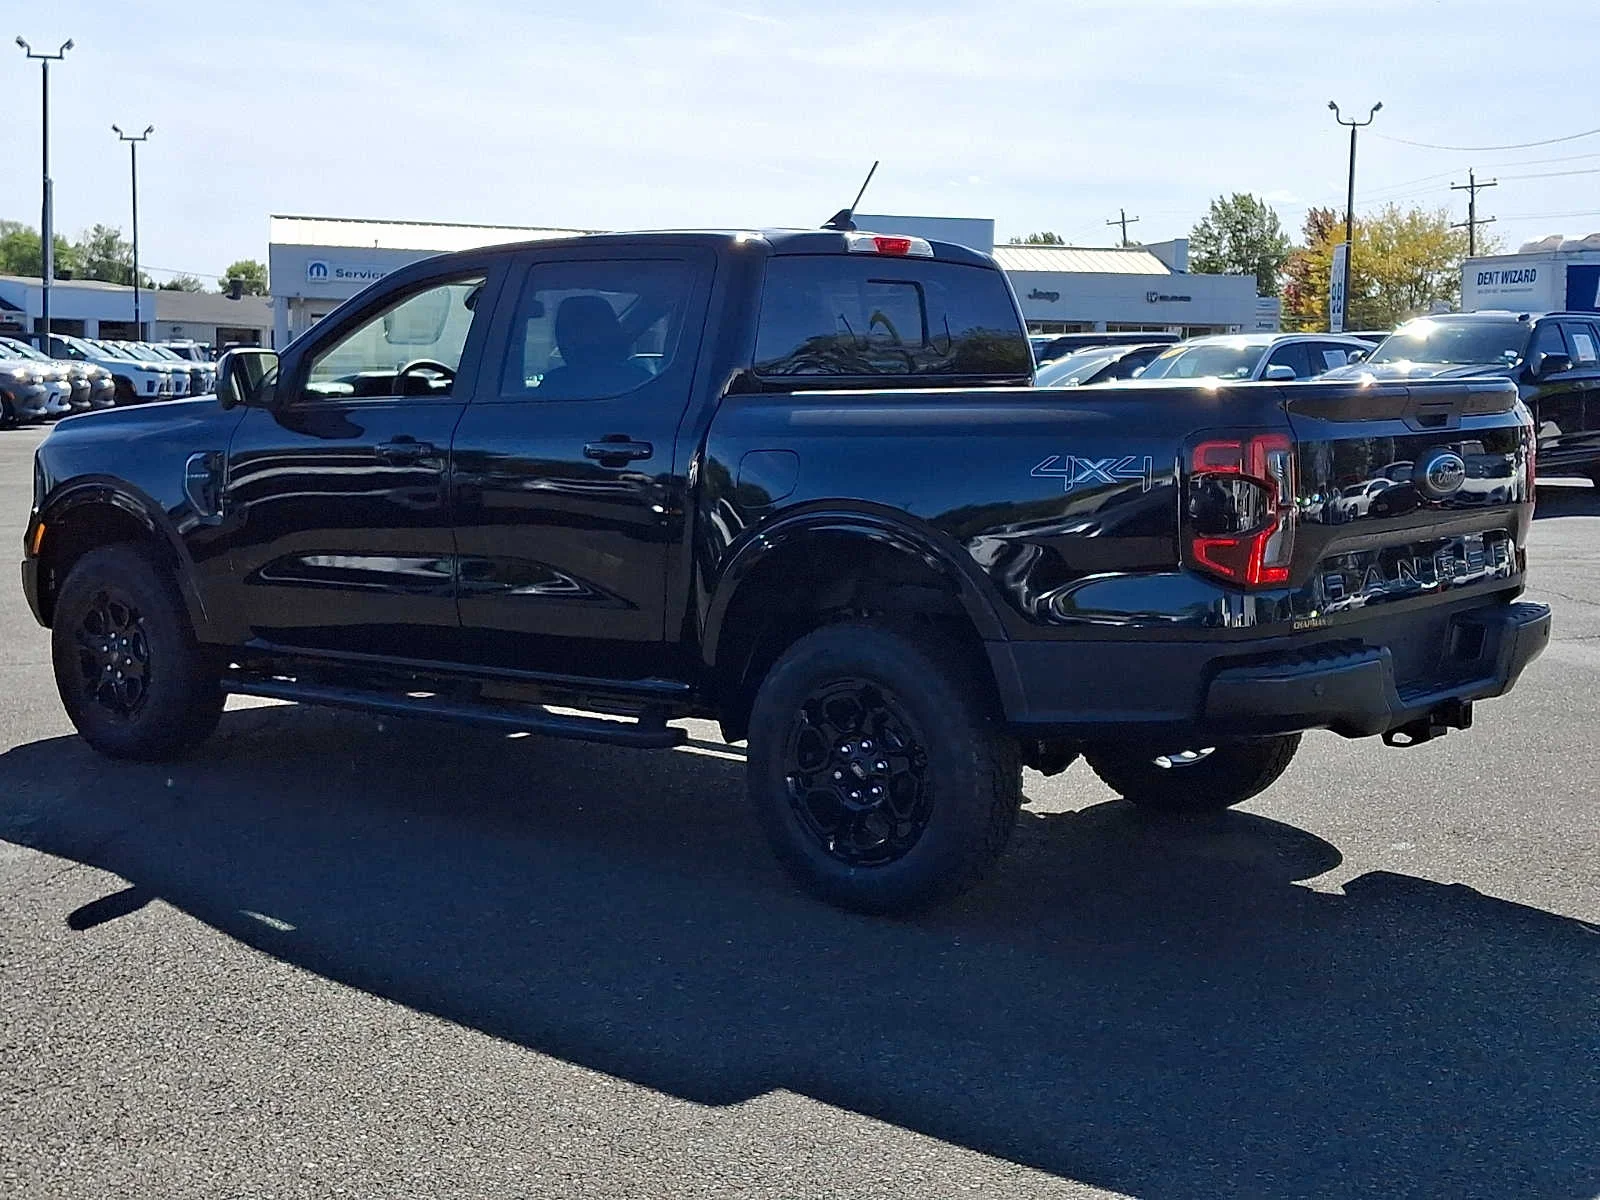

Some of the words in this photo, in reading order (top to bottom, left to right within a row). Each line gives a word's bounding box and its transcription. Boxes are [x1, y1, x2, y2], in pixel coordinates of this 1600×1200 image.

[1477, 271, 1499, 286] DENT
[1501, 268, 1537, 284] WIZARD
[1028, 288, 1060, 303] Jeep
